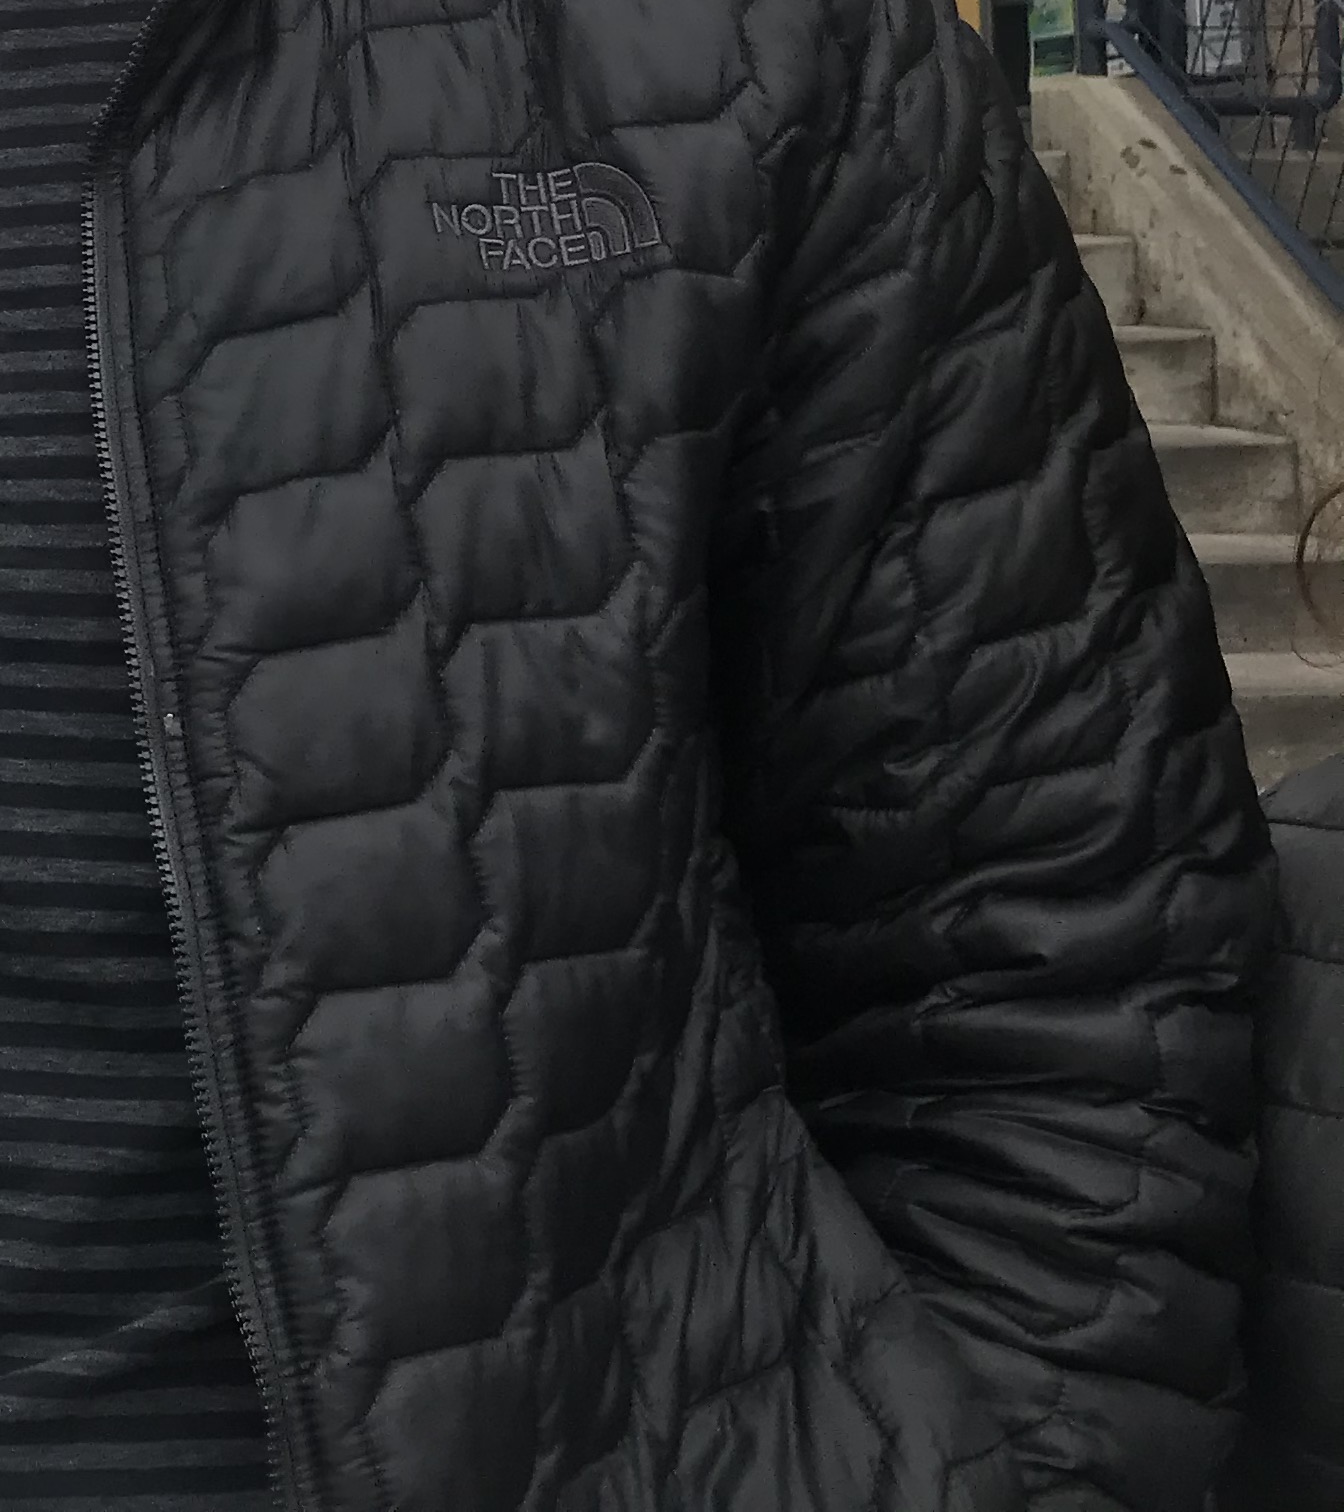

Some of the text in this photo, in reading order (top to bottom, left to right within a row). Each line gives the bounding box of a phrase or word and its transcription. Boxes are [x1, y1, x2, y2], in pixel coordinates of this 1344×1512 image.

[491, 168, 577, 205] THE
[432, 199, 583, 238] NORTH
[478, 234, 589, 270] FACE
